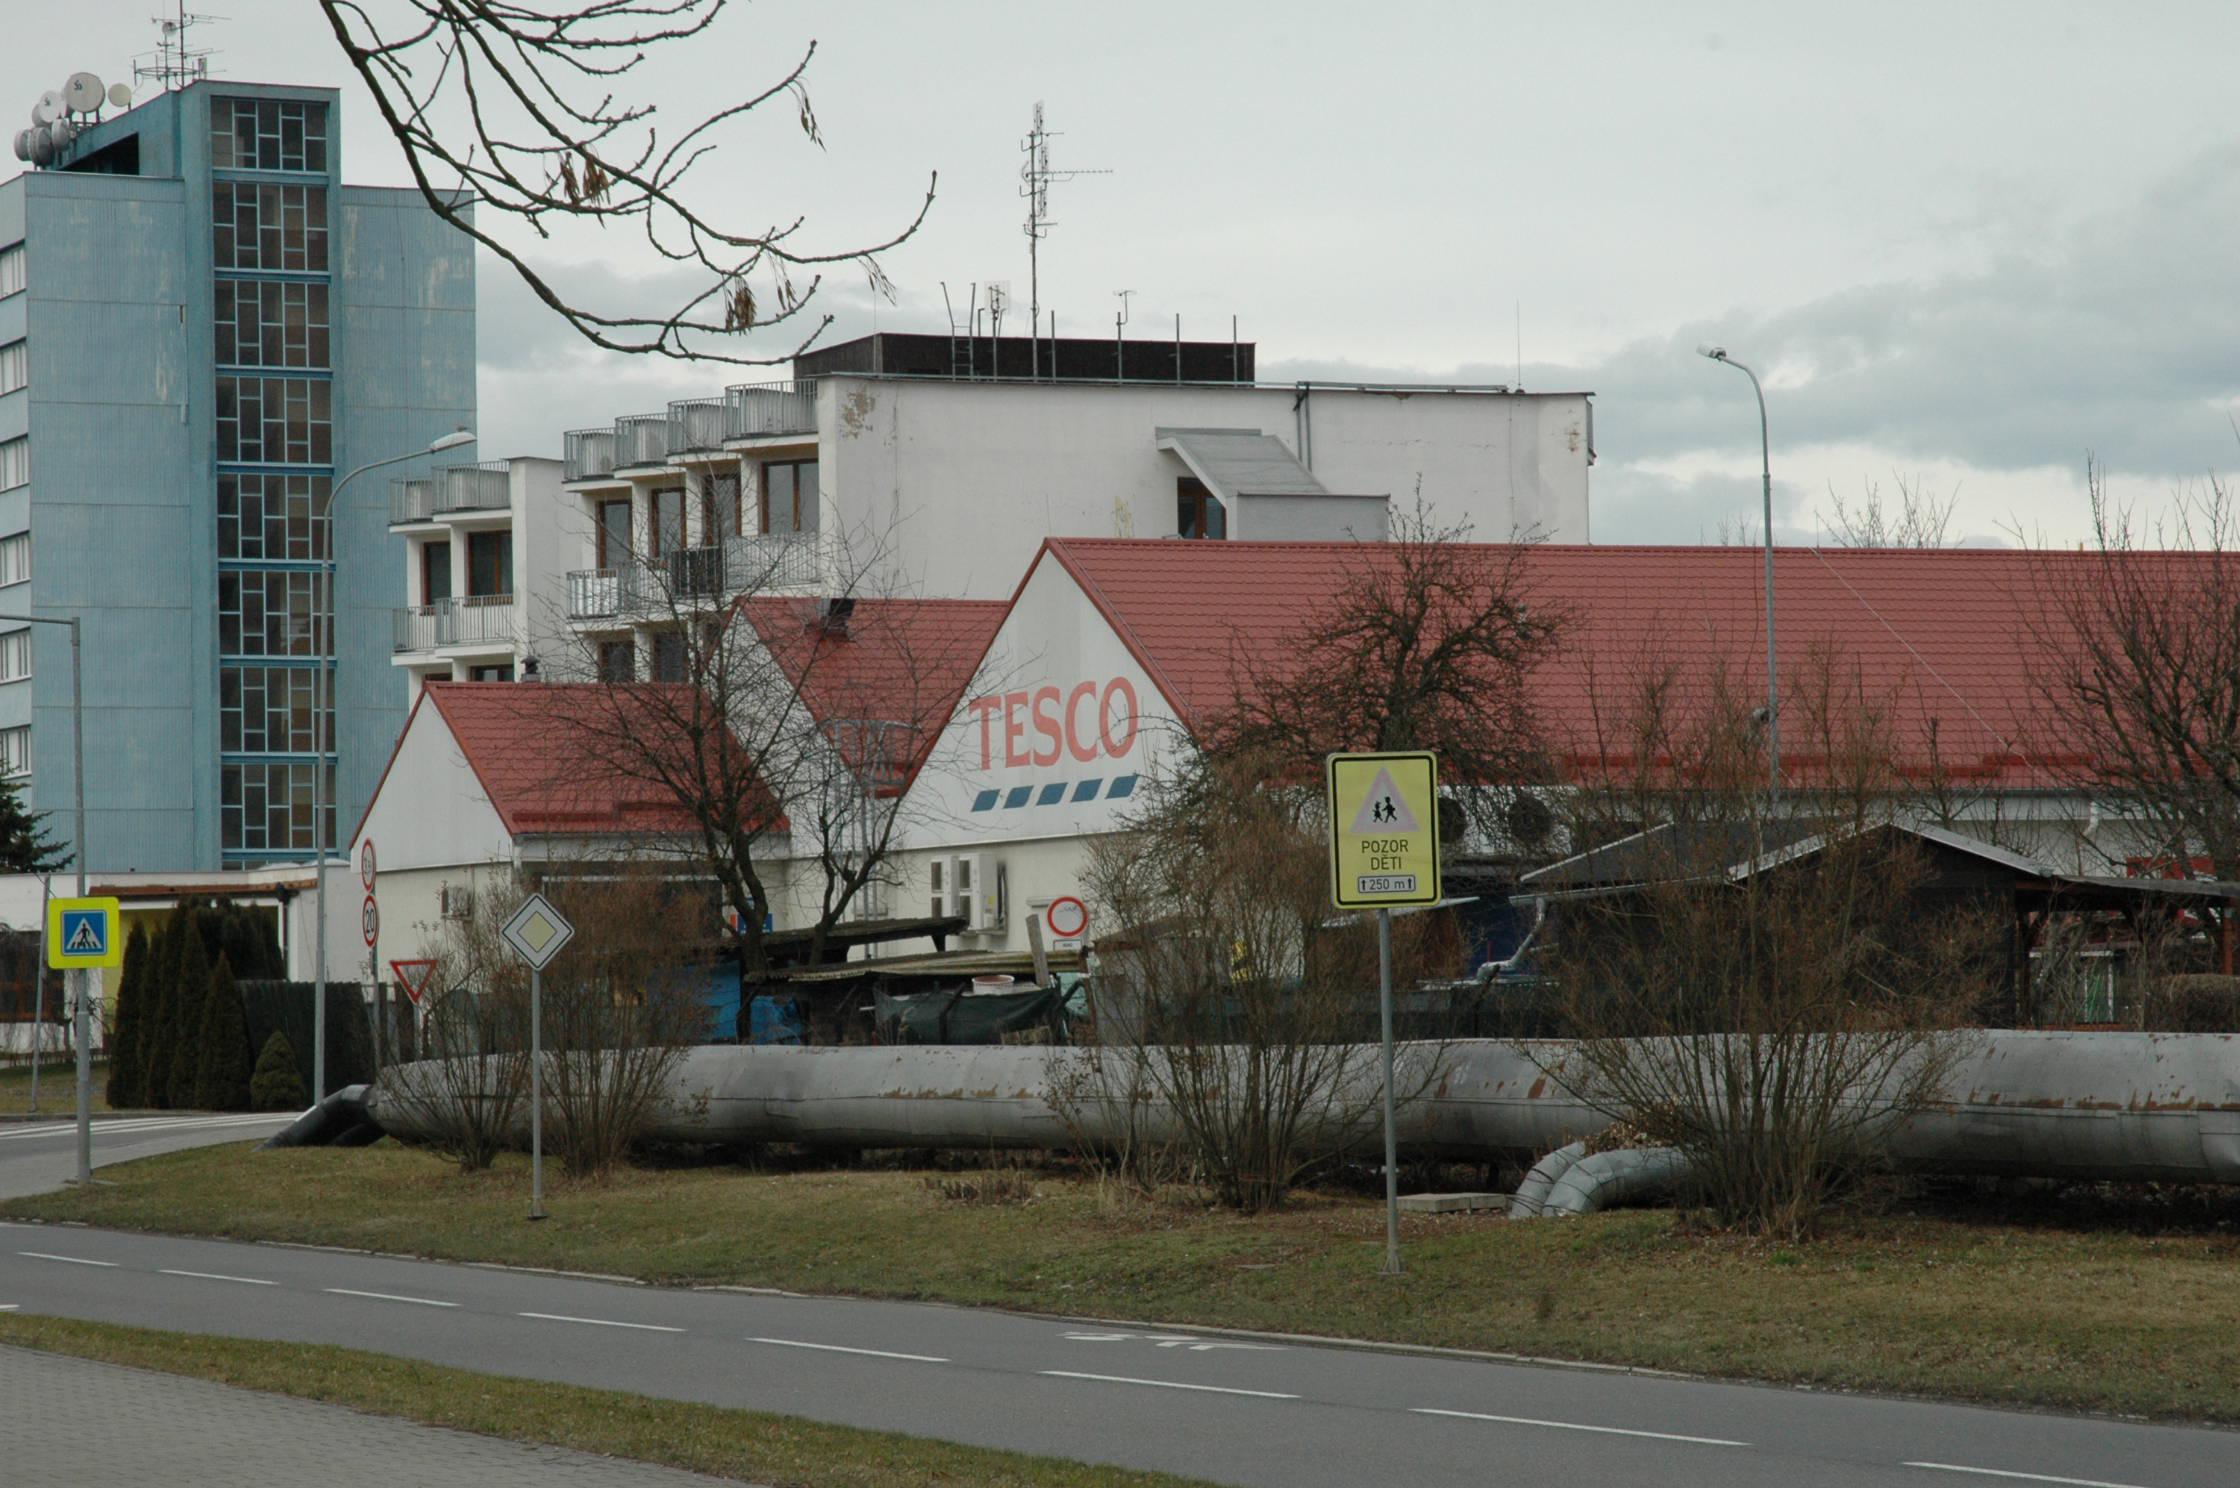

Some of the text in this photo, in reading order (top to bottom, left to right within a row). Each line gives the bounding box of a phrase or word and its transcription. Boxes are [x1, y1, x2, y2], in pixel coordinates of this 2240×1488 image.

[969, 677, 1138, 771] TESCO
[1361, 839, 1408, 853] POZOR
[1370, 854, 1401, 870] DĚTI
[1369, 878, 1405, 890] 250 m
[365, 907, 375, 934] 20
